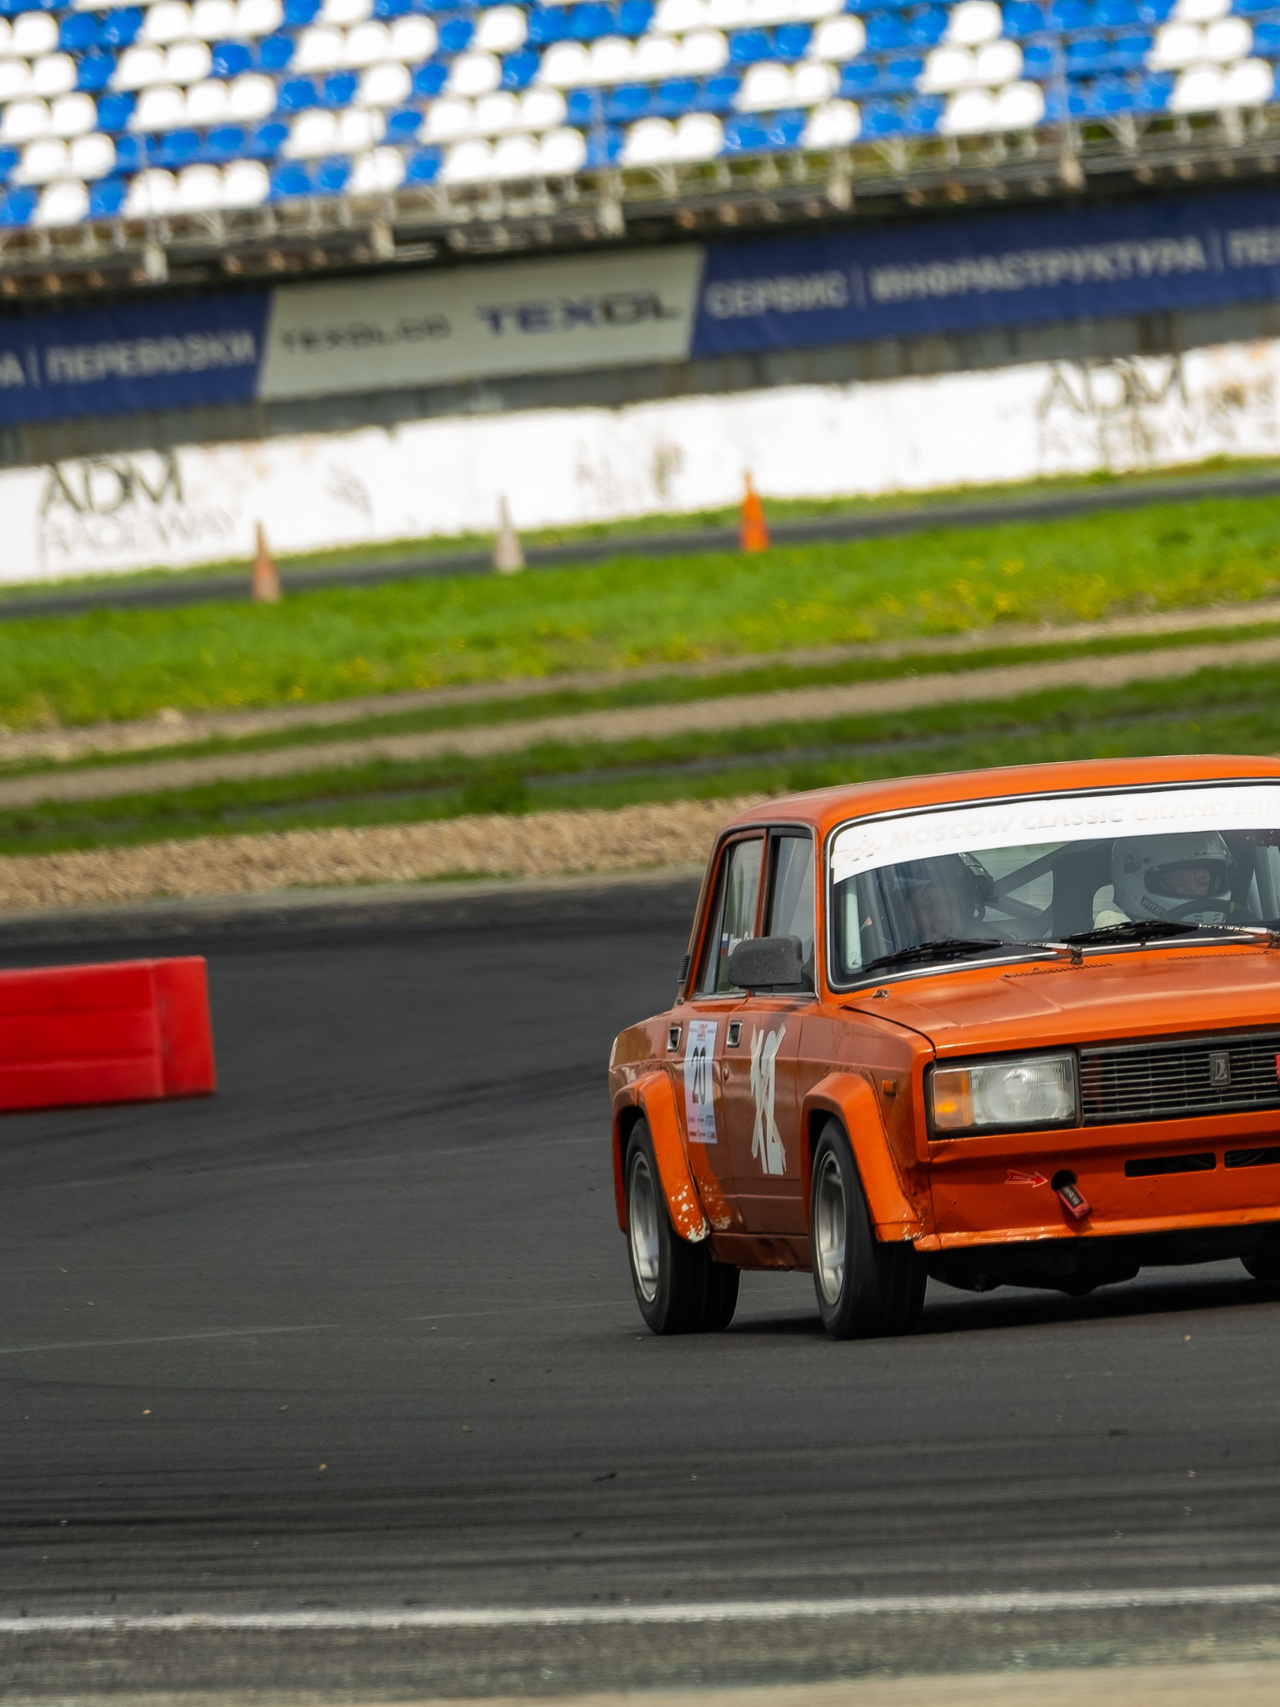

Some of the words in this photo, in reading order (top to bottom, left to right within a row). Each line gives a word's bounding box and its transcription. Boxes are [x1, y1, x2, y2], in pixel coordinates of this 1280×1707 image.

[703, 270, 850, 319] СЕРВИС
[868, 235, 1207, 301] ИНФРАСТРУКТУРА
[478, 288, 684, 338] TEXOL
[46, 330, 255, 385] ПЕРЕВОЗКИ
[1035, 353, 1192, 419] ADM
[36, 450, 184, 517] ADM
[888, 815, 1016, 850] MOSCOW
[1021, 807, 1125, 830] CLASSIC
[1131, 799, 1227, 822] GRAND
[691, 1045, 707, 1106] 20
